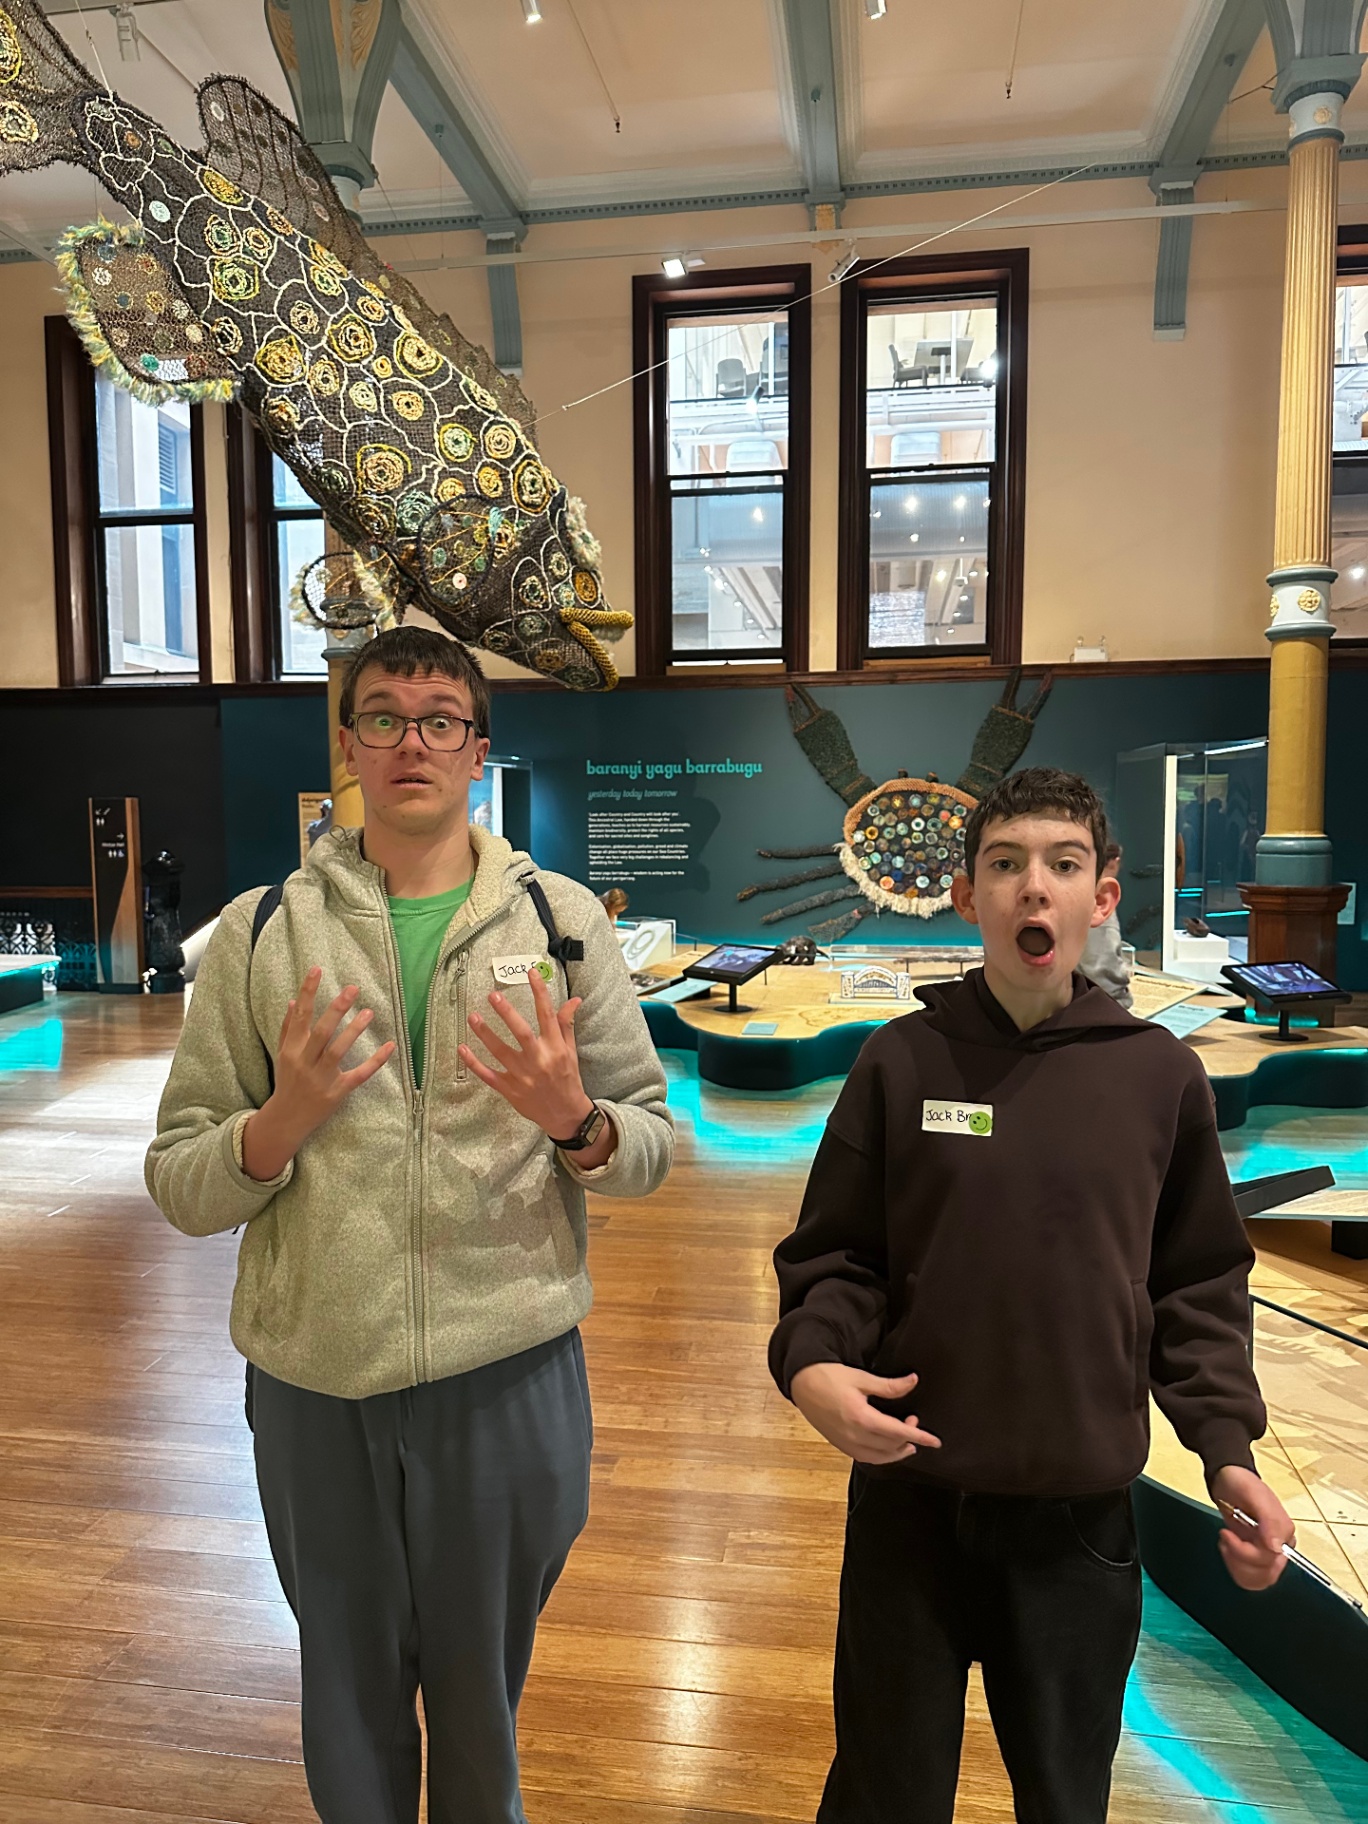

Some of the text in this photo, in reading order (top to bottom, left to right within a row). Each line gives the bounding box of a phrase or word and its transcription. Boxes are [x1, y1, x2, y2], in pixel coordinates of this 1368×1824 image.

[586, 758, 763, 780] baranyi yagu barrabugu
[587, 788, 678, 801] yesterday today tomorrow
[498, 964, 529, 978] Jack
[957, 1109, 972, 1122] Br
